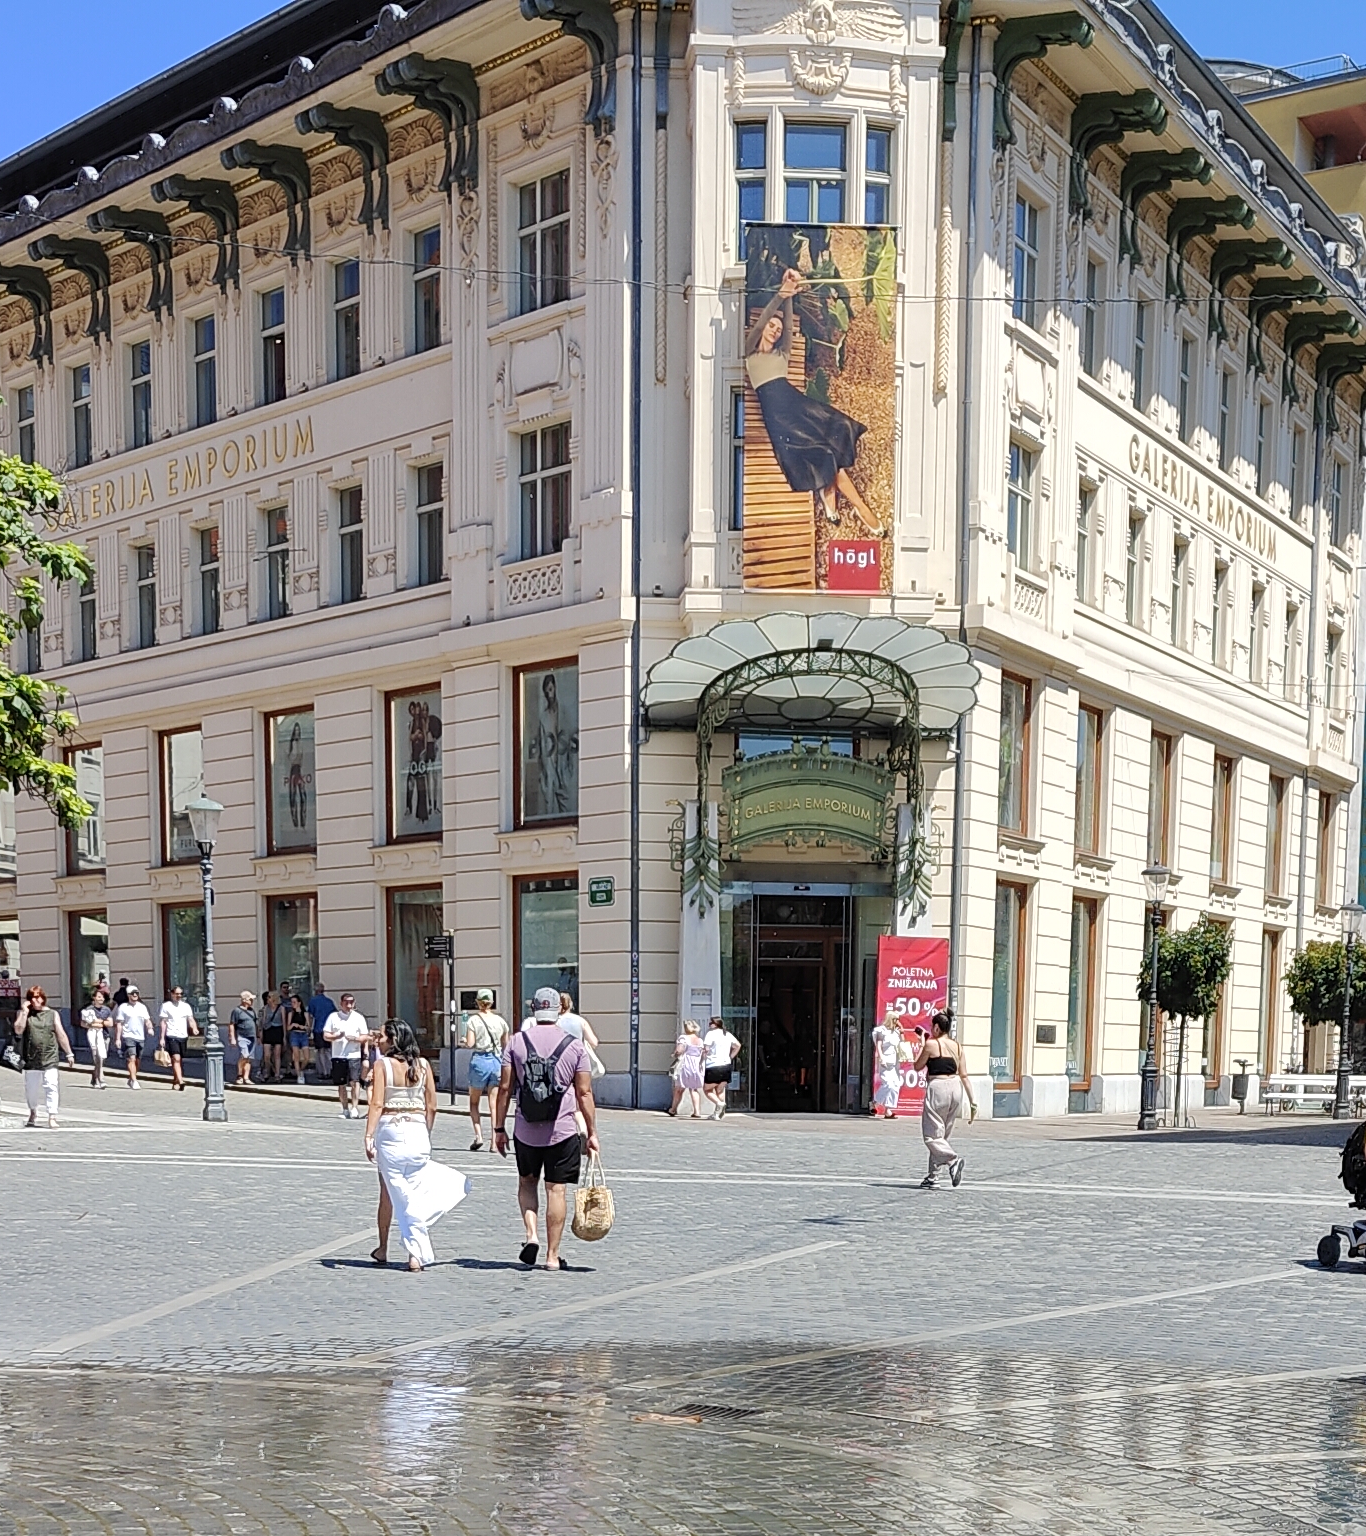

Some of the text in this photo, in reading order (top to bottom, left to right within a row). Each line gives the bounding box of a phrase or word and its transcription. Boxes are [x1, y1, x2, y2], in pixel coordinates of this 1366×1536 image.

[165, 414, 316, 497] EMPORIUM
[1128, 433, 1278, 565] GALERIJA EMPORIUM
[744, 797, 872, 822] GALERIJA EMPORIUM
[887, 977, 938, 990] ZNIŽANJA
[892, 966, 935, 978] POLETNA
